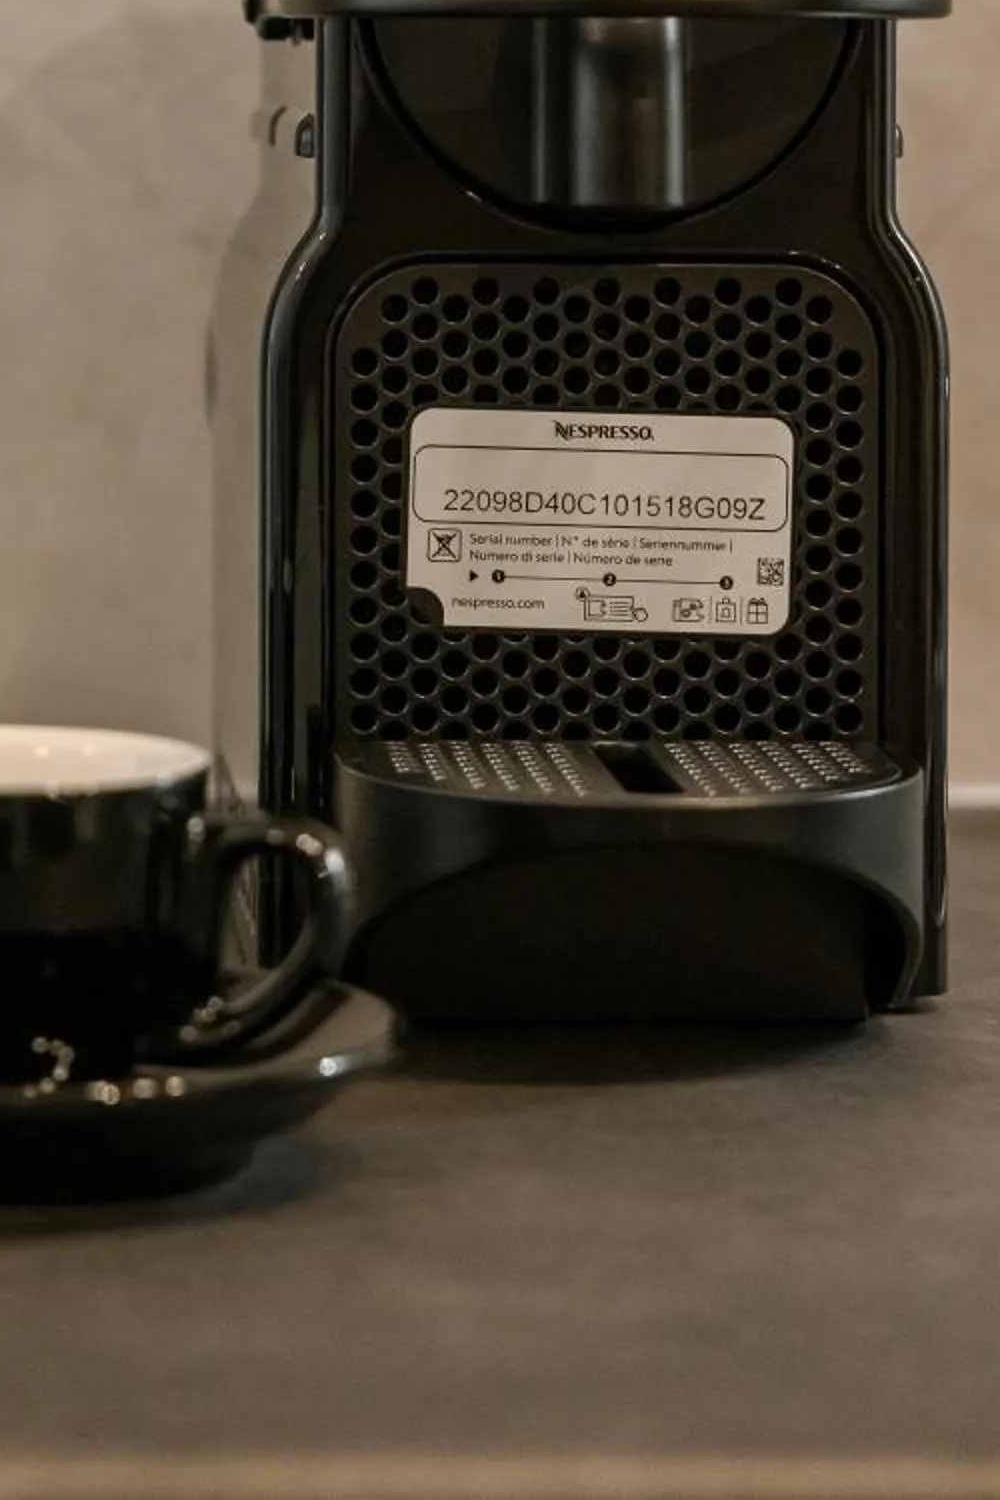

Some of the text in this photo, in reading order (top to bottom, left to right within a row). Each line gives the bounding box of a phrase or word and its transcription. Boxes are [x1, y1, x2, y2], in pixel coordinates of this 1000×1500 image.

[443, 489, 766, 521] 22098D40C101518G09Z
[469, 532, 503, 545] Serial
[505, 534, 553, 546] number
[582, 536, 599, 548] de
[469, 549, 519, 562] Numero
[521, 551, 533, 563] di
[535, 552, 565, 563] serie
[574, 552, 623, 565] Número
[625, 554, 641, 565] de
[451, 597, 545, 610] nespresso.com
